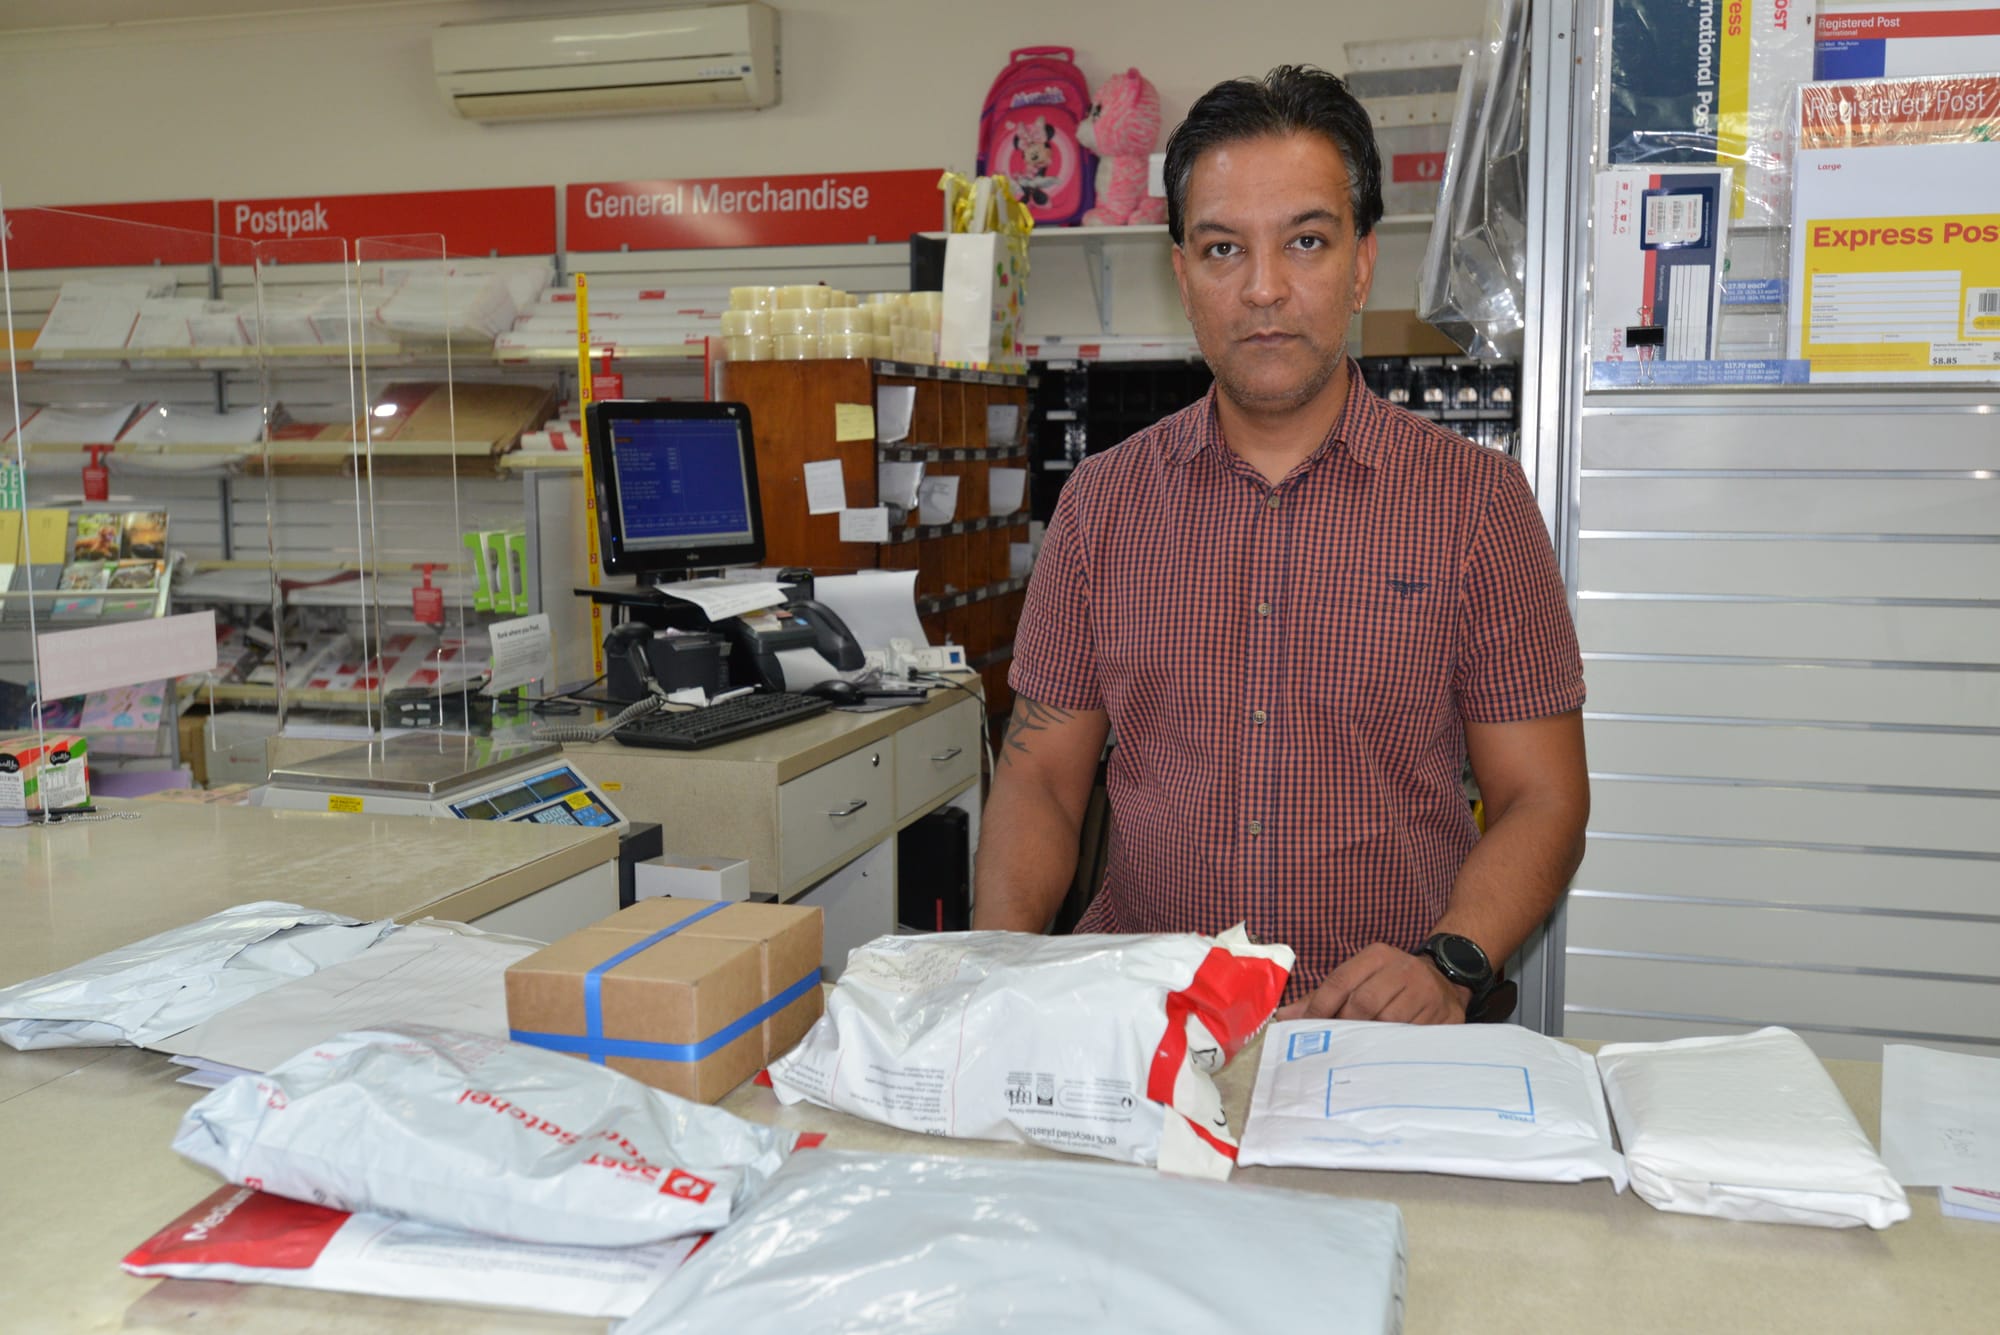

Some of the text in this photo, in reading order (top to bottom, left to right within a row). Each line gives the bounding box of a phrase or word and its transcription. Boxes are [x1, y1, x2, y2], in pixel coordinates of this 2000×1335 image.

[1728, 0, 1742, 37] ess
[1818, 15, 1901, 30] Registered Post
[1695, 91, 1714, 136] Post
[1937, 89, 1987, 113] Post
[1817, 162, 1842, 172] Large
[584, 179, 870, 219] General Merchandise
[234, 201, 329, 239] Postpak
[1813, 222, 2000, 252] Express Pos
[454, 1088, 583, 1147] Satchel
[1024, 1127, 1056, 1138] plastic
[1056, 1130, 1095, 1142] recycled
